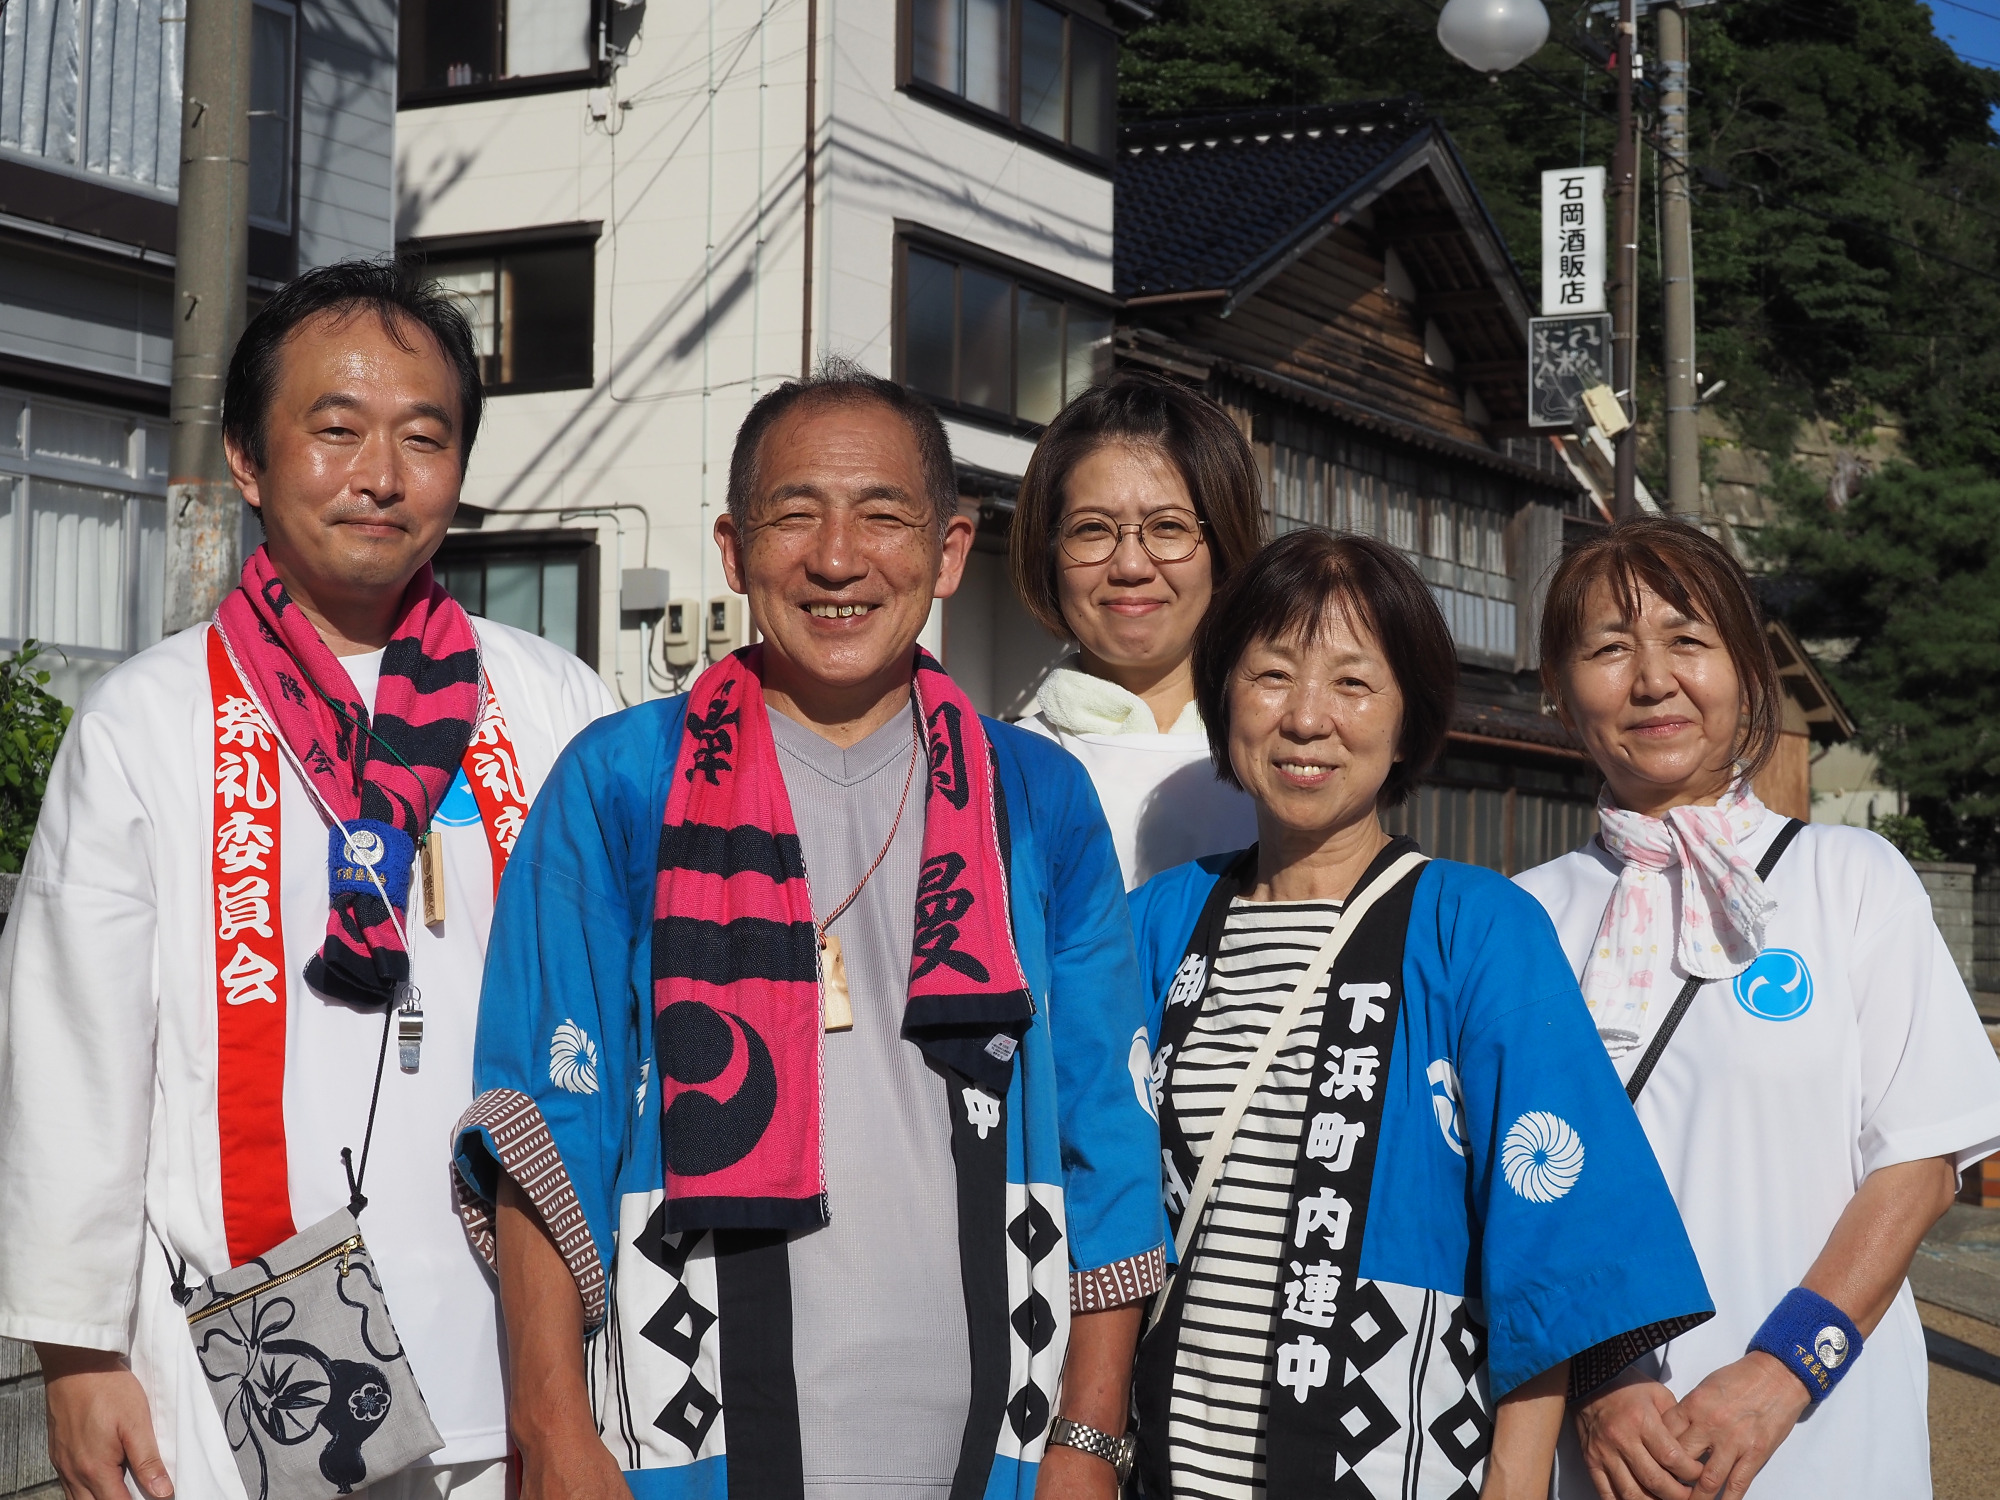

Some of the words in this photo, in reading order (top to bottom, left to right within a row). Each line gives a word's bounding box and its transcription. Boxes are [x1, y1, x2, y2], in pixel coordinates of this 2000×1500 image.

[1558, 176, 1587, 305] 石岡酒販店
[215, 693, 279, 1006] 祭礼委員会
[1276, 980, 1394, 1405] 下浜町内連中
